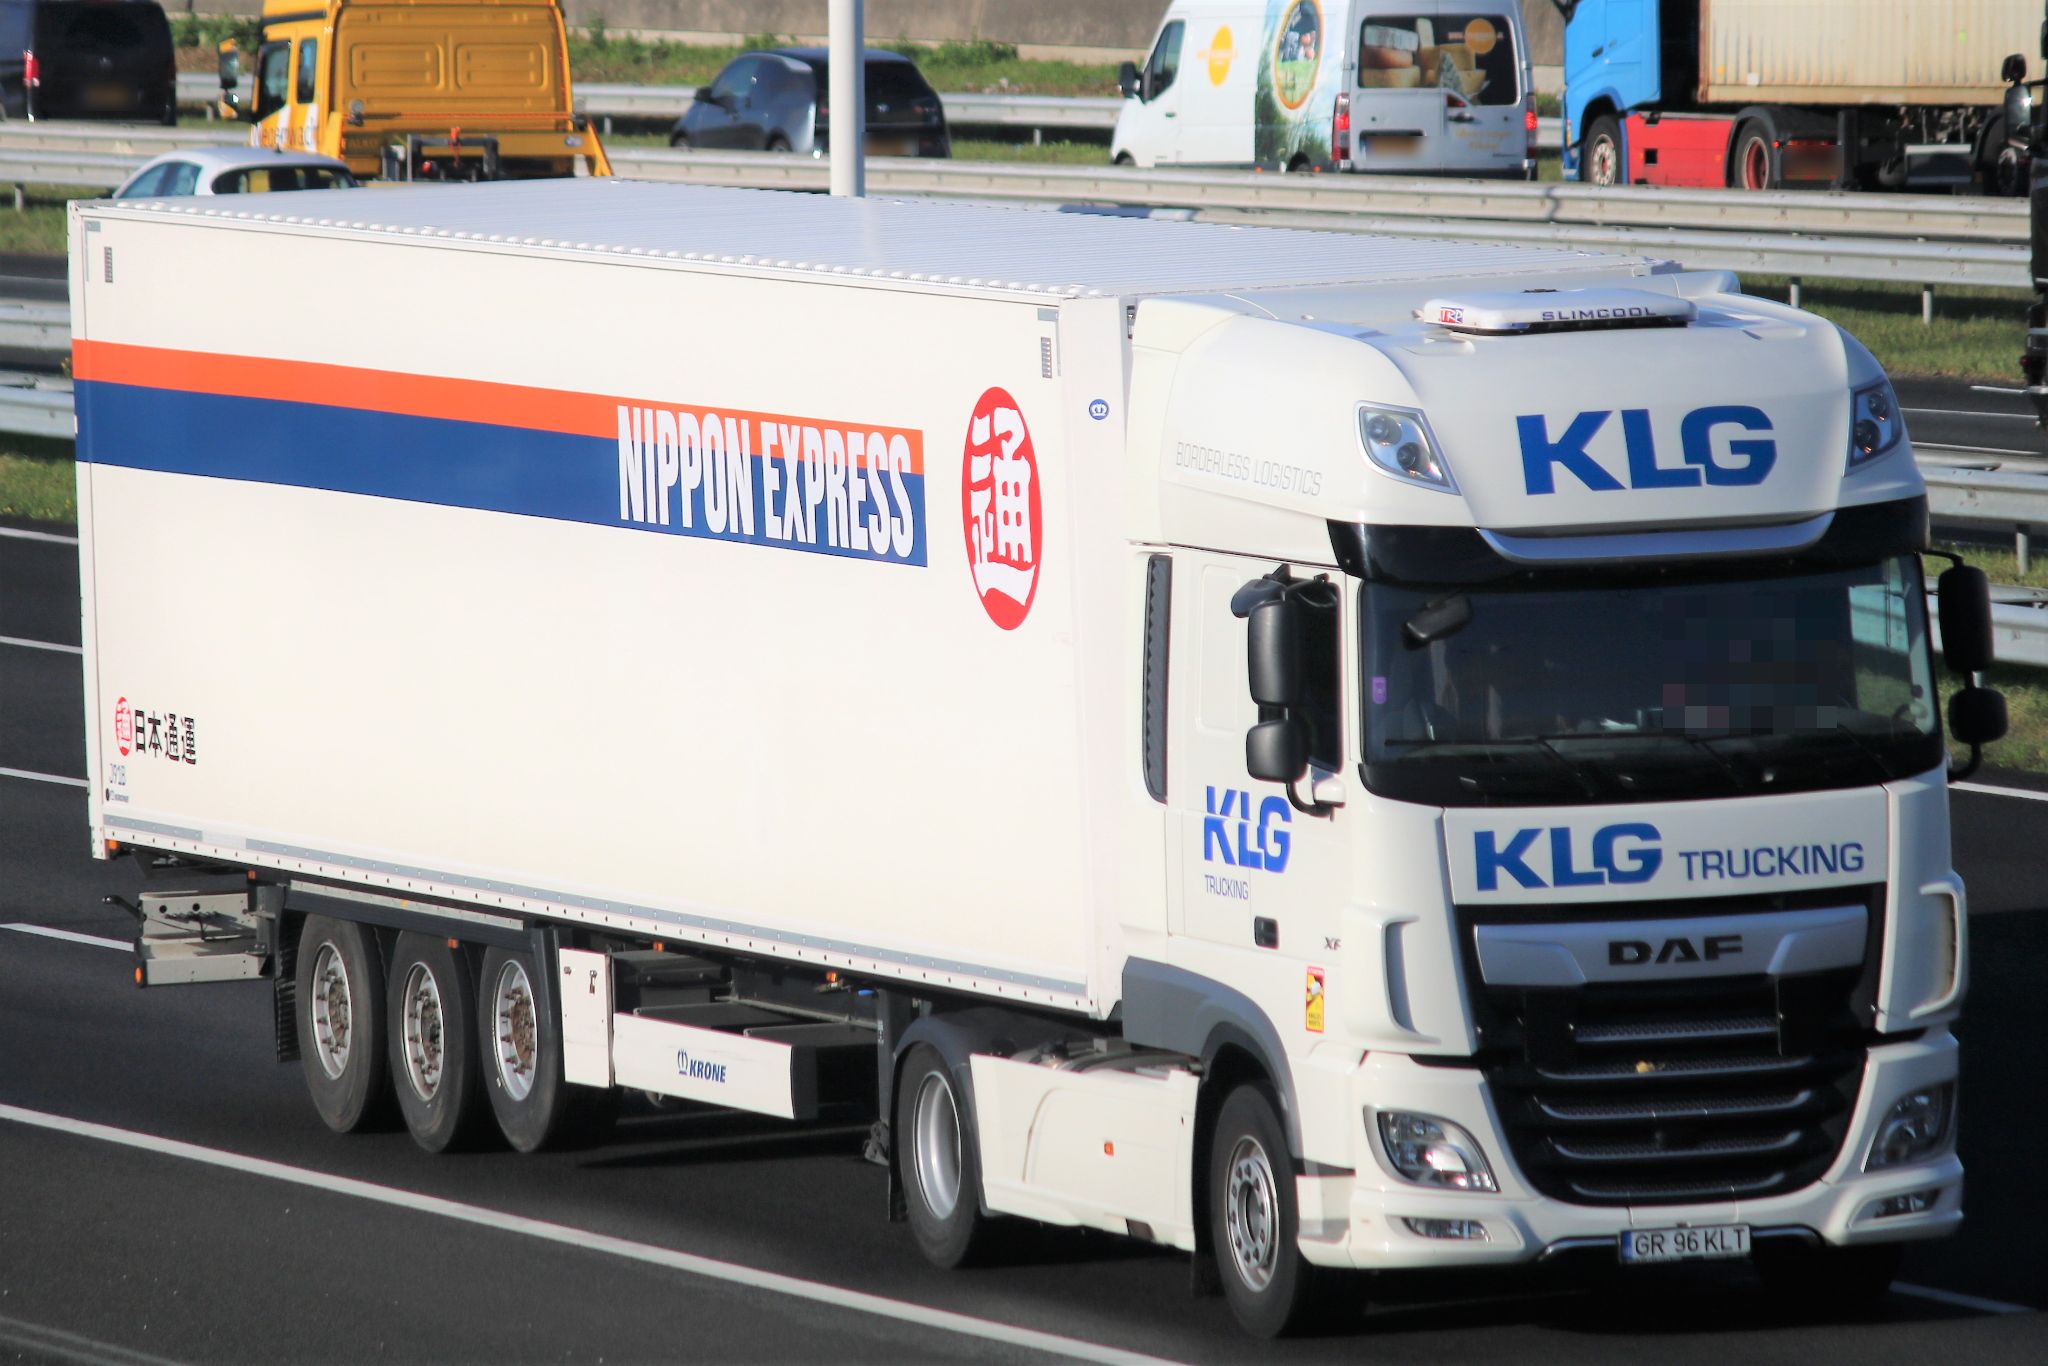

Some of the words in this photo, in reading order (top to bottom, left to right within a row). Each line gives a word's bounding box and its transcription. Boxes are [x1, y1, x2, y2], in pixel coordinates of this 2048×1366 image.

[1542, 307, 1657, 322] SLIMCOOL
[1175, 441, 1250, 481] BORDERLESS
[1253, 460, 1322, 496] LOGISTICS
[1516, 405, 1778, 495] KLG
[617, 405, 755, 535] NIPPON
[760, 421, 915, 558] EXPRESS
[135, 709, 197, 765] 日本通運
[1204, 785, 1292, 873] KLG
[1474, 822, 1662, 891] KLG
[1678, 842, 1865, 881] TRUCKING
[1204, 873, 1249, 900] TRUCKING
[1608, 934, 1743, 966] DAF
[689, 1058, 727, 1083] KRONE
[1635, 1231, 1665, 1256] GR
